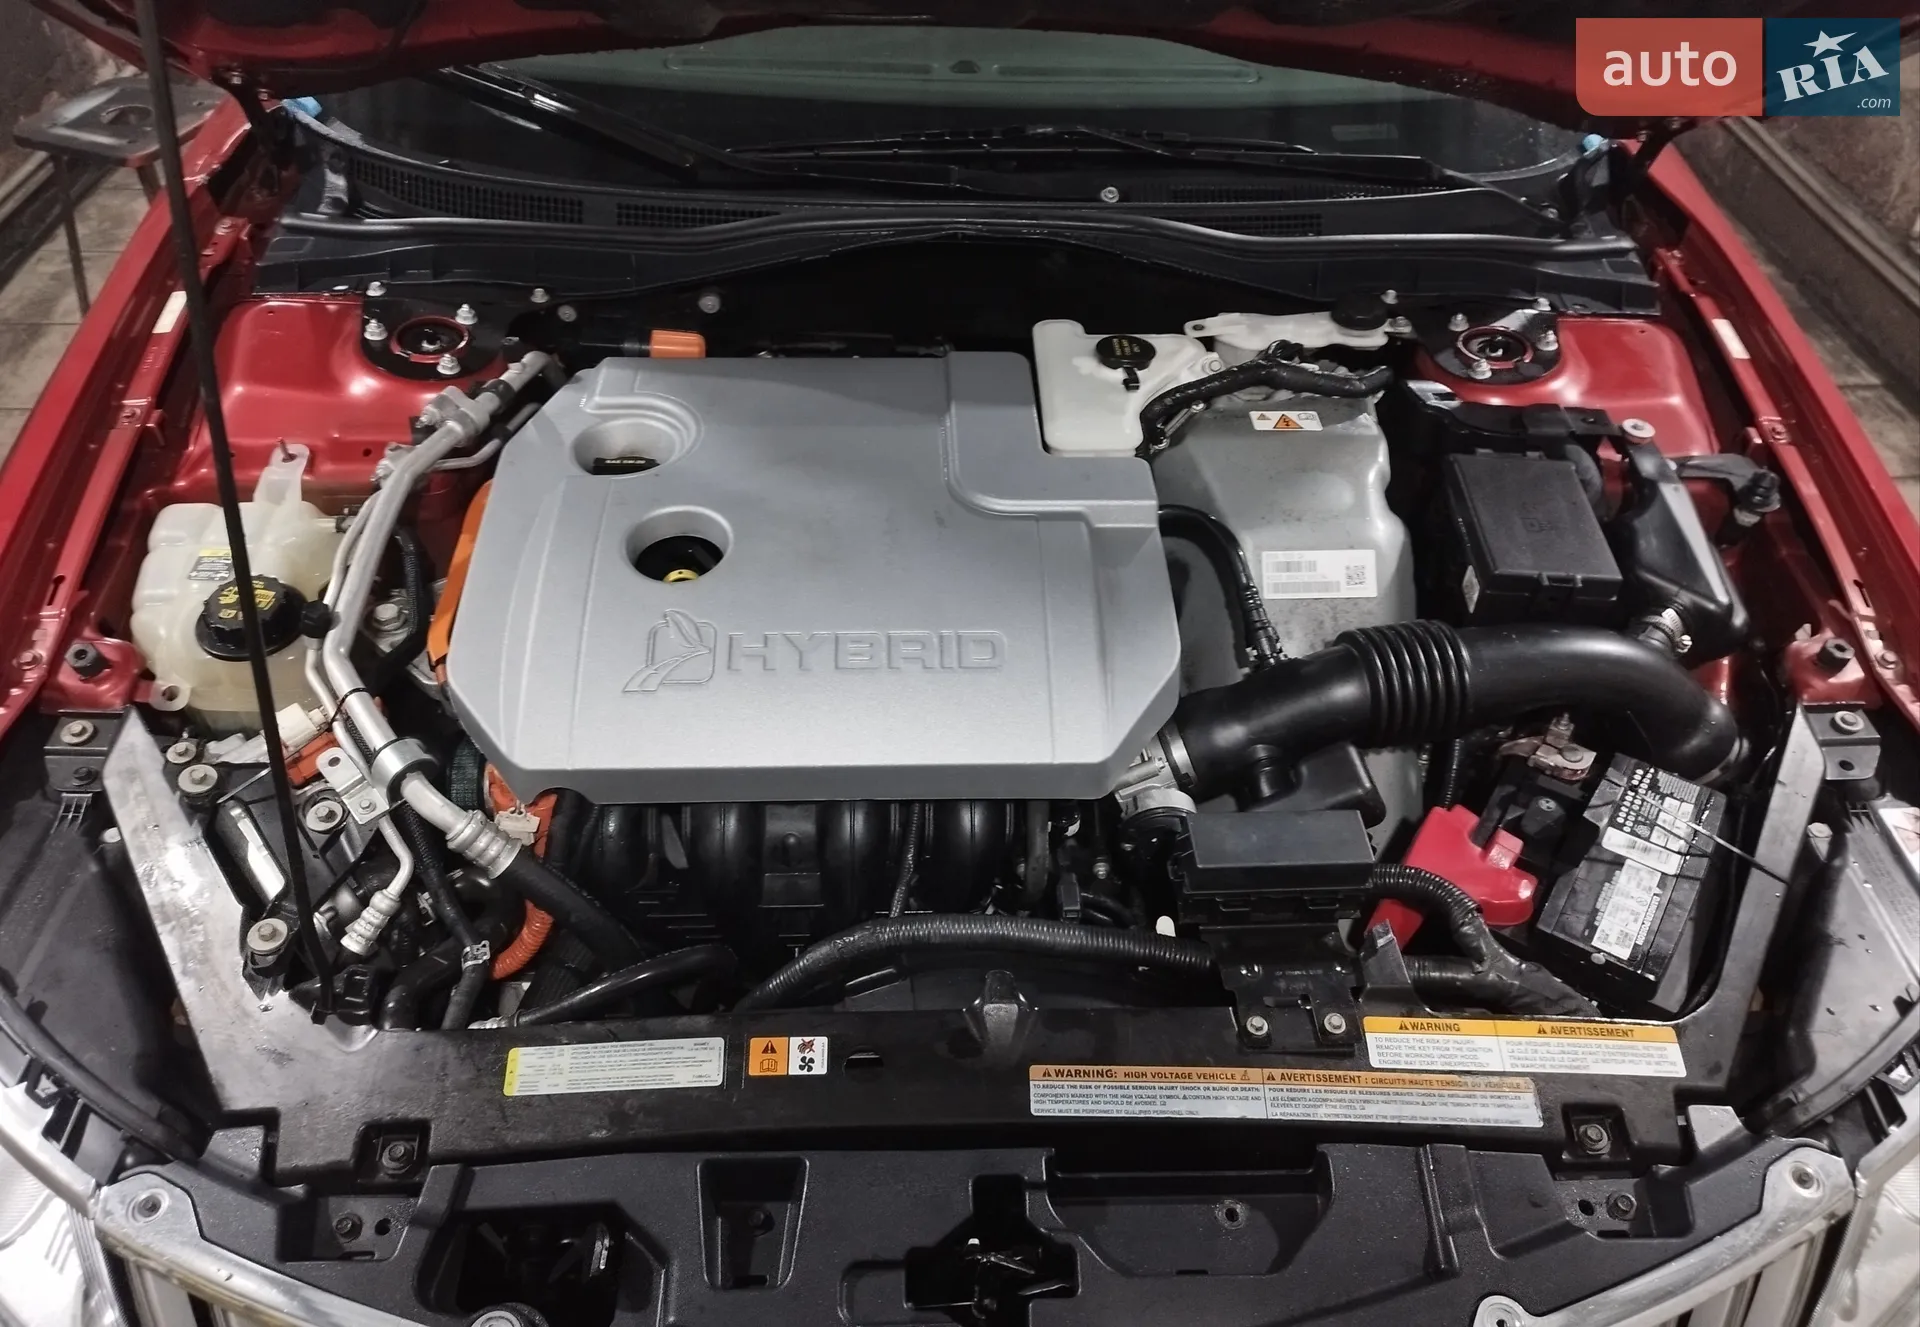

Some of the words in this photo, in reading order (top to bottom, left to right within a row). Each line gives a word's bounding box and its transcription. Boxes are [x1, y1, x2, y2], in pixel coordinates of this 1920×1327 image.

[727, 630, 1008, 671] HYBRID
[1409, 1021, 1460, 1032] WARNING
[1550, 1025, 1634, 1038] AVERTISSEMENT
[1054, 1067, 1117, 1079] WARNING:
[1123, 1070, 1148, 1079] HIGH
[1150, 1071, 1193, 1080] VOLTAGE
[1195, 1072, 1236, 1080] VEHICLE
[1279, 1071, 1361, 1084] AVERTISSEMENT
[1370, 1076, 1406, 1085] CIRCUITS
[1407, 1078, 1433, 1086] HAUTE
